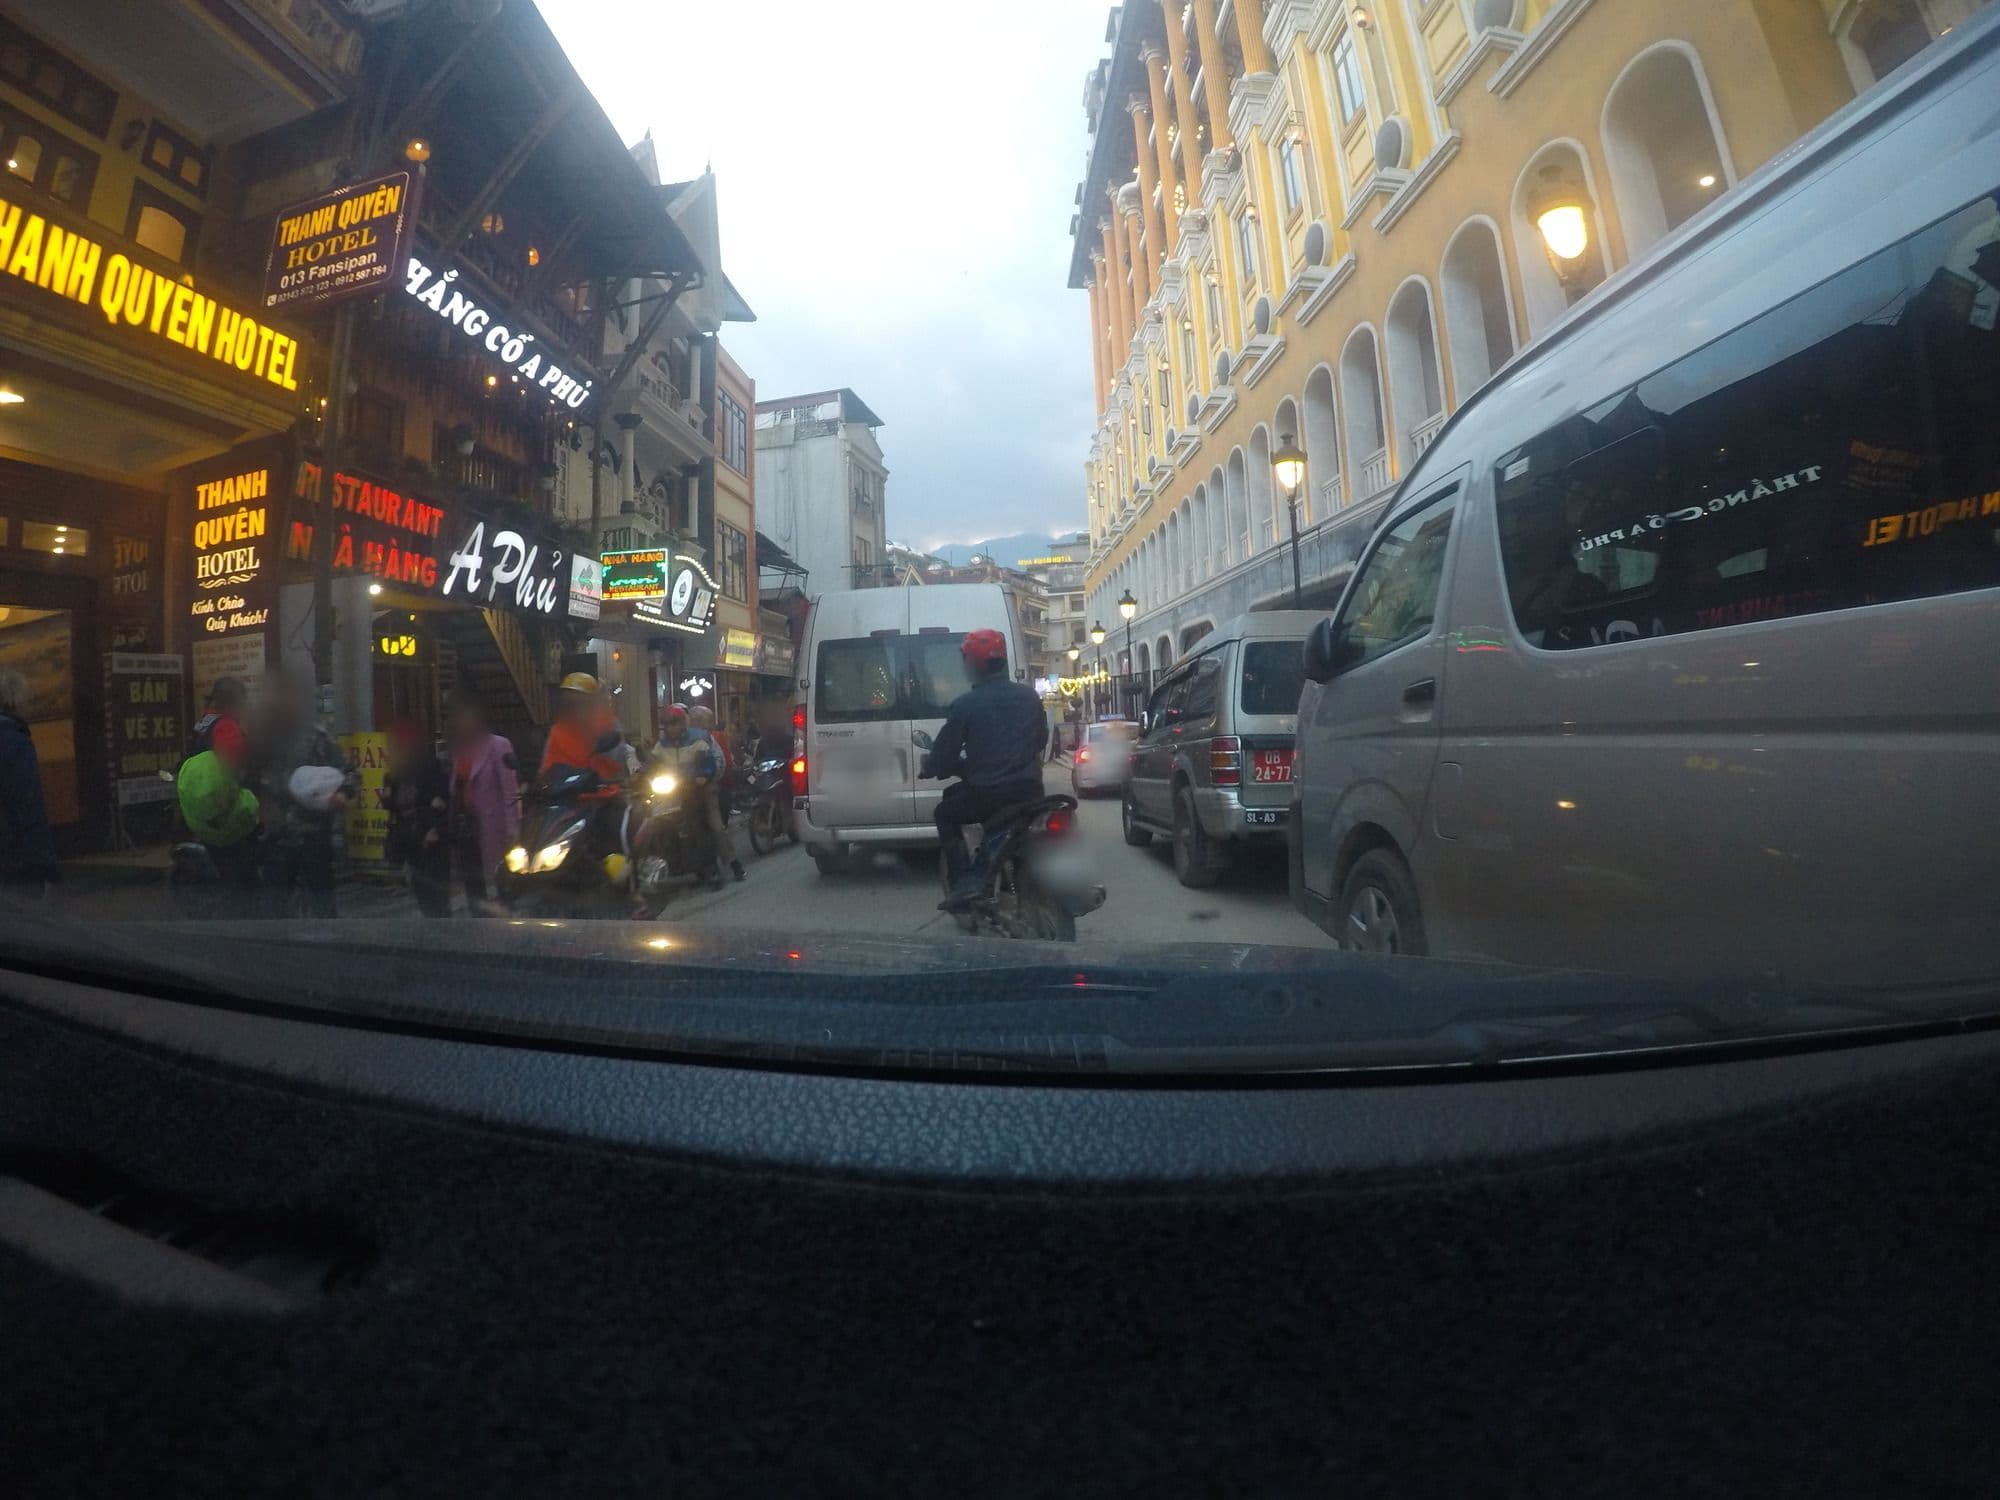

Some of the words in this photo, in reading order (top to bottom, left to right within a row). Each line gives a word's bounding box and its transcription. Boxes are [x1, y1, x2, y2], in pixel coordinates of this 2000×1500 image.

[280, 203, 337, 247] THANH
[338, 184, 401, 230] QUYÊN
[286, 226, 378, 270] HOTEL
[280, 269, 306, 289] 013
[308, 252, 378, 281] Fansipan
[0, 197, 103, 305] HANH
[101, 254, 217, 353] QUYÊN
[214, 308, 299, 392] HOTEL
[405, 258, 490, 337] HẮNG
[517, 354, 542, 379] A
[538, 364, 593, 409] PHỦ
[196, 469, 268, 511] THANH
[296, 461, 447, 539] RSTAURANT
[194, 507, 267, 550] QUYÊN
[196, 546, 261, 580] HOTEL
[288, 521, 354, 570] NÀ
[363, 538, 438, 588] HÀNG
[442, 521, 485, 596] A
[488, 530, 563, 614] Phủ
[217, 594, 246, 612] Chào
[229, 608, 269, 629] Khách!
[129, 676, 169, 703] BÁN
[152, 716, 176, 738] XE
[1246, 812, 1258, 823] SL
[1264, 812, 1276, 823] A3
